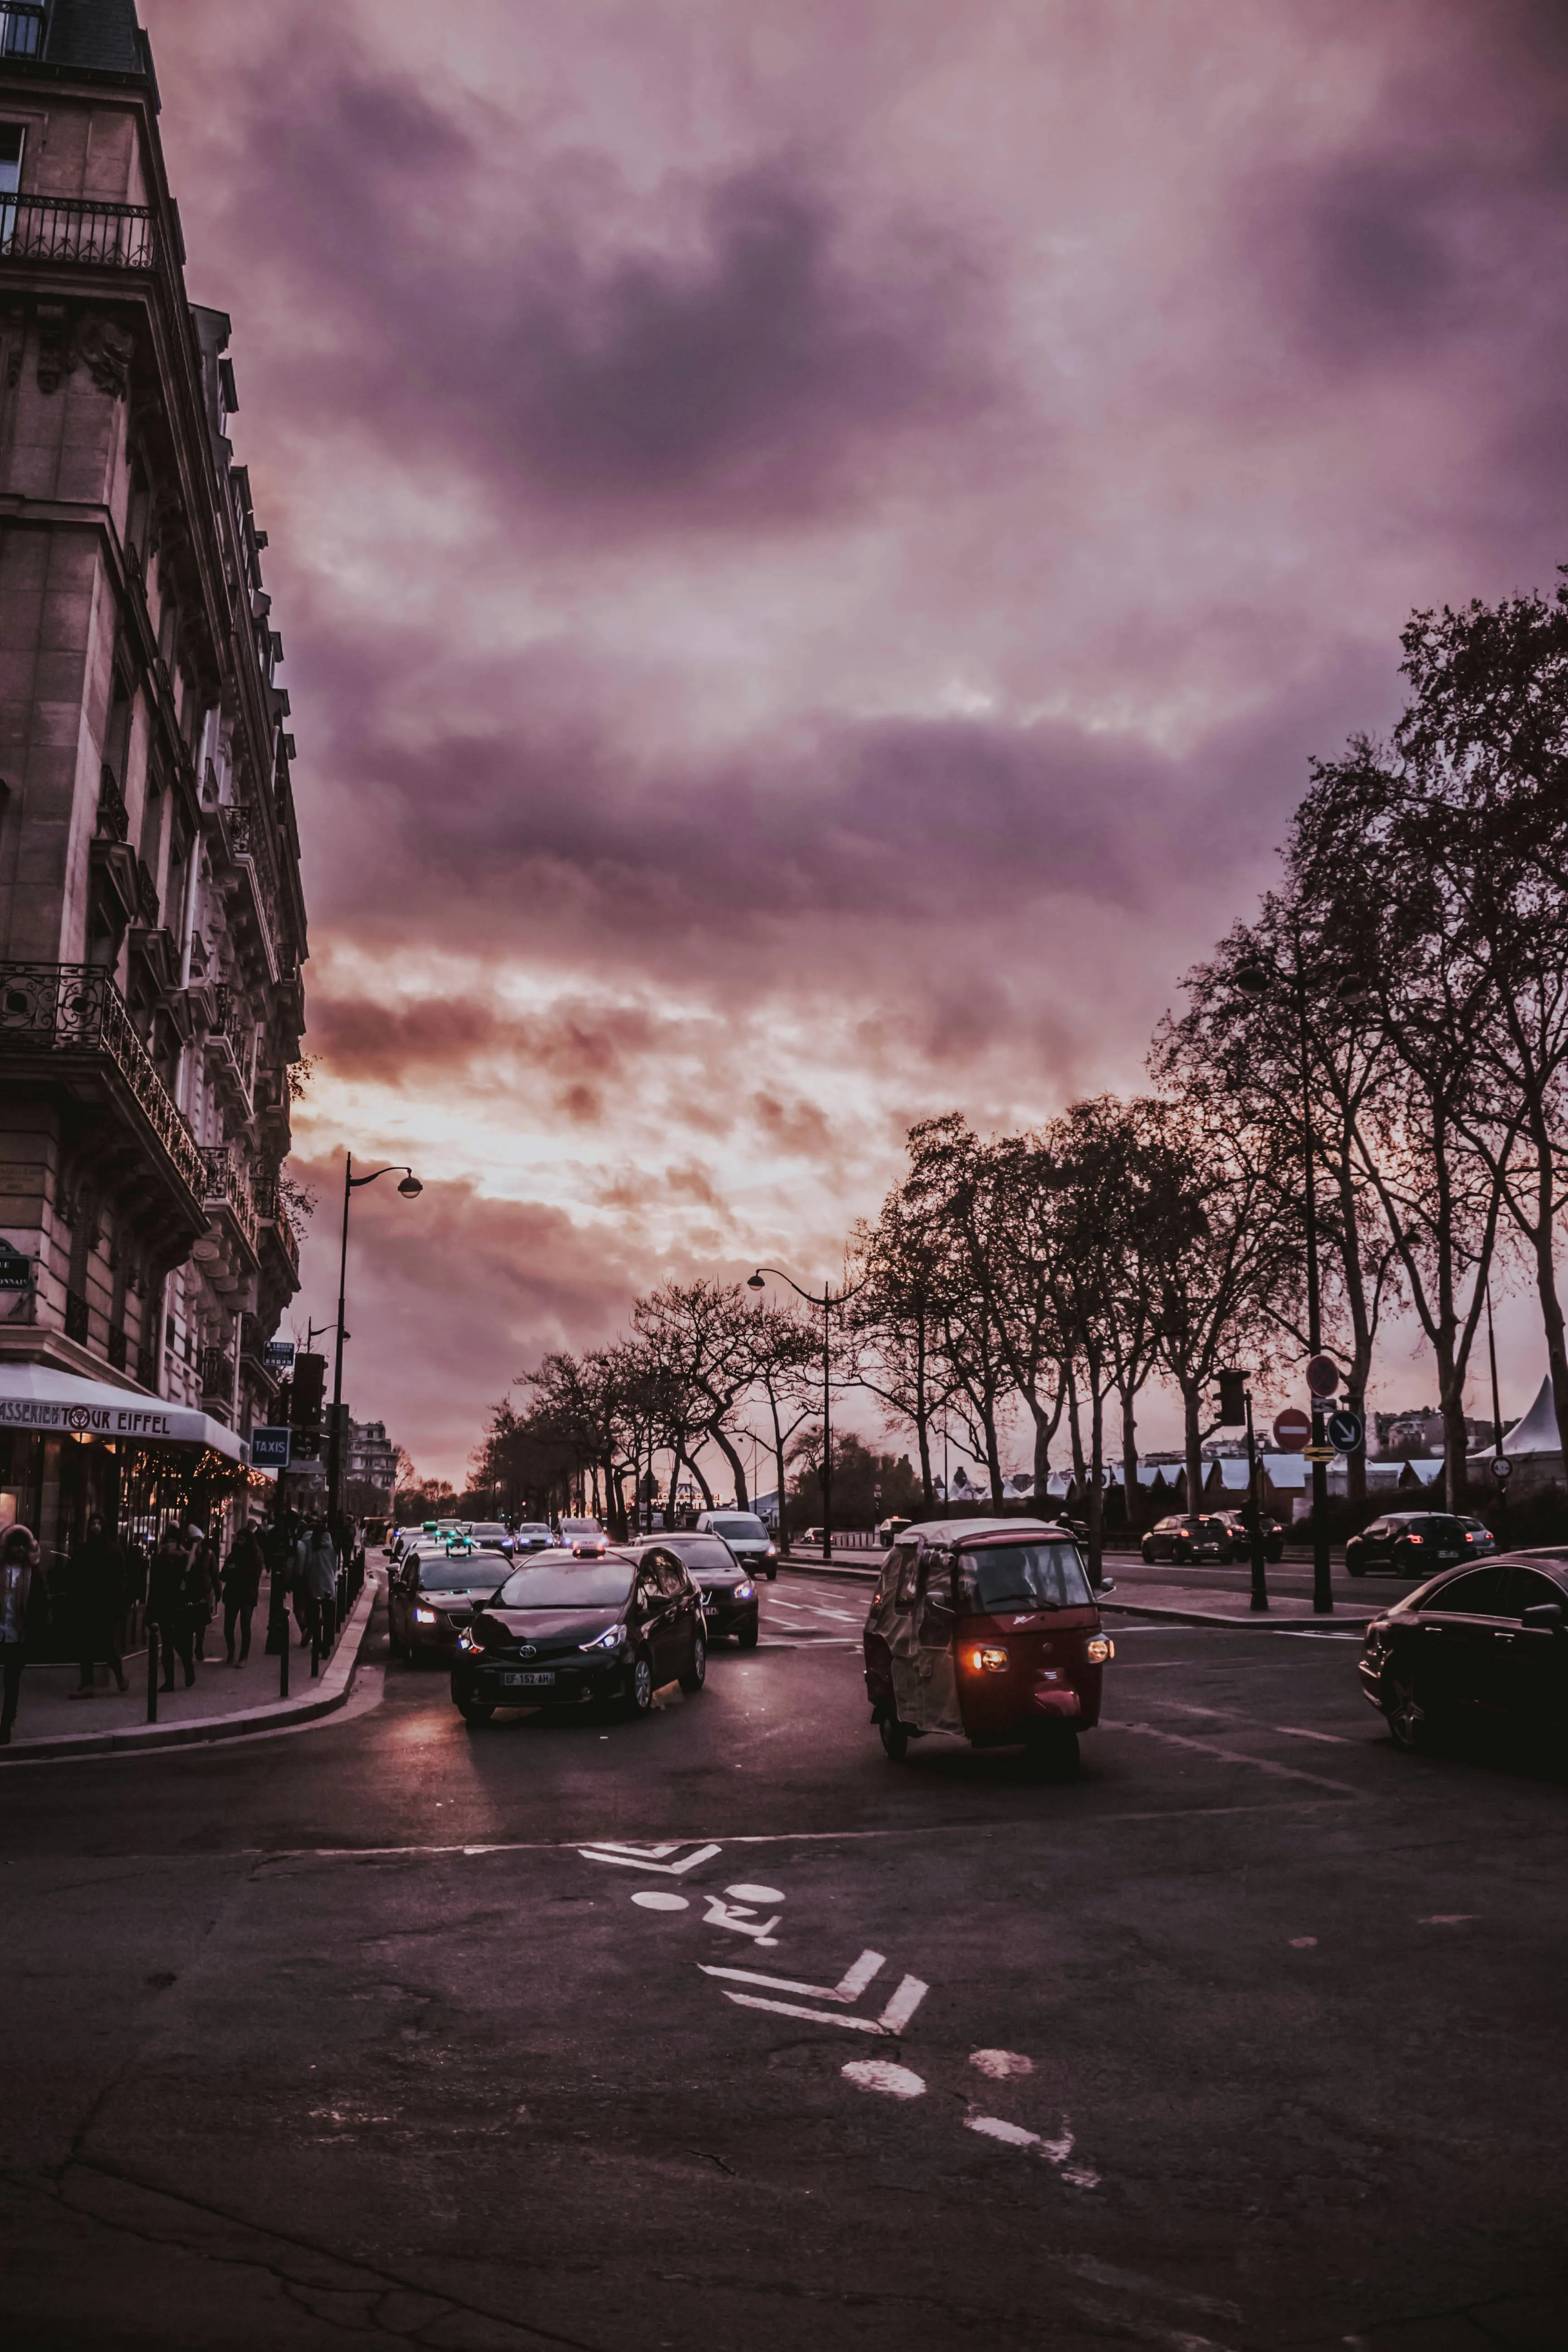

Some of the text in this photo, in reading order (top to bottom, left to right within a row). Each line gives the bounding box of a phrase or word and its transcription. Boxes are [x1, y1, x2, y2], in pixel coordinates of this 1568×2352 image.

[61, 1406, 110, 1430] TOUR
[118, 1413, 170, 1435] EIFFEL
[255, 1441, 285, 1453] TAXIS
